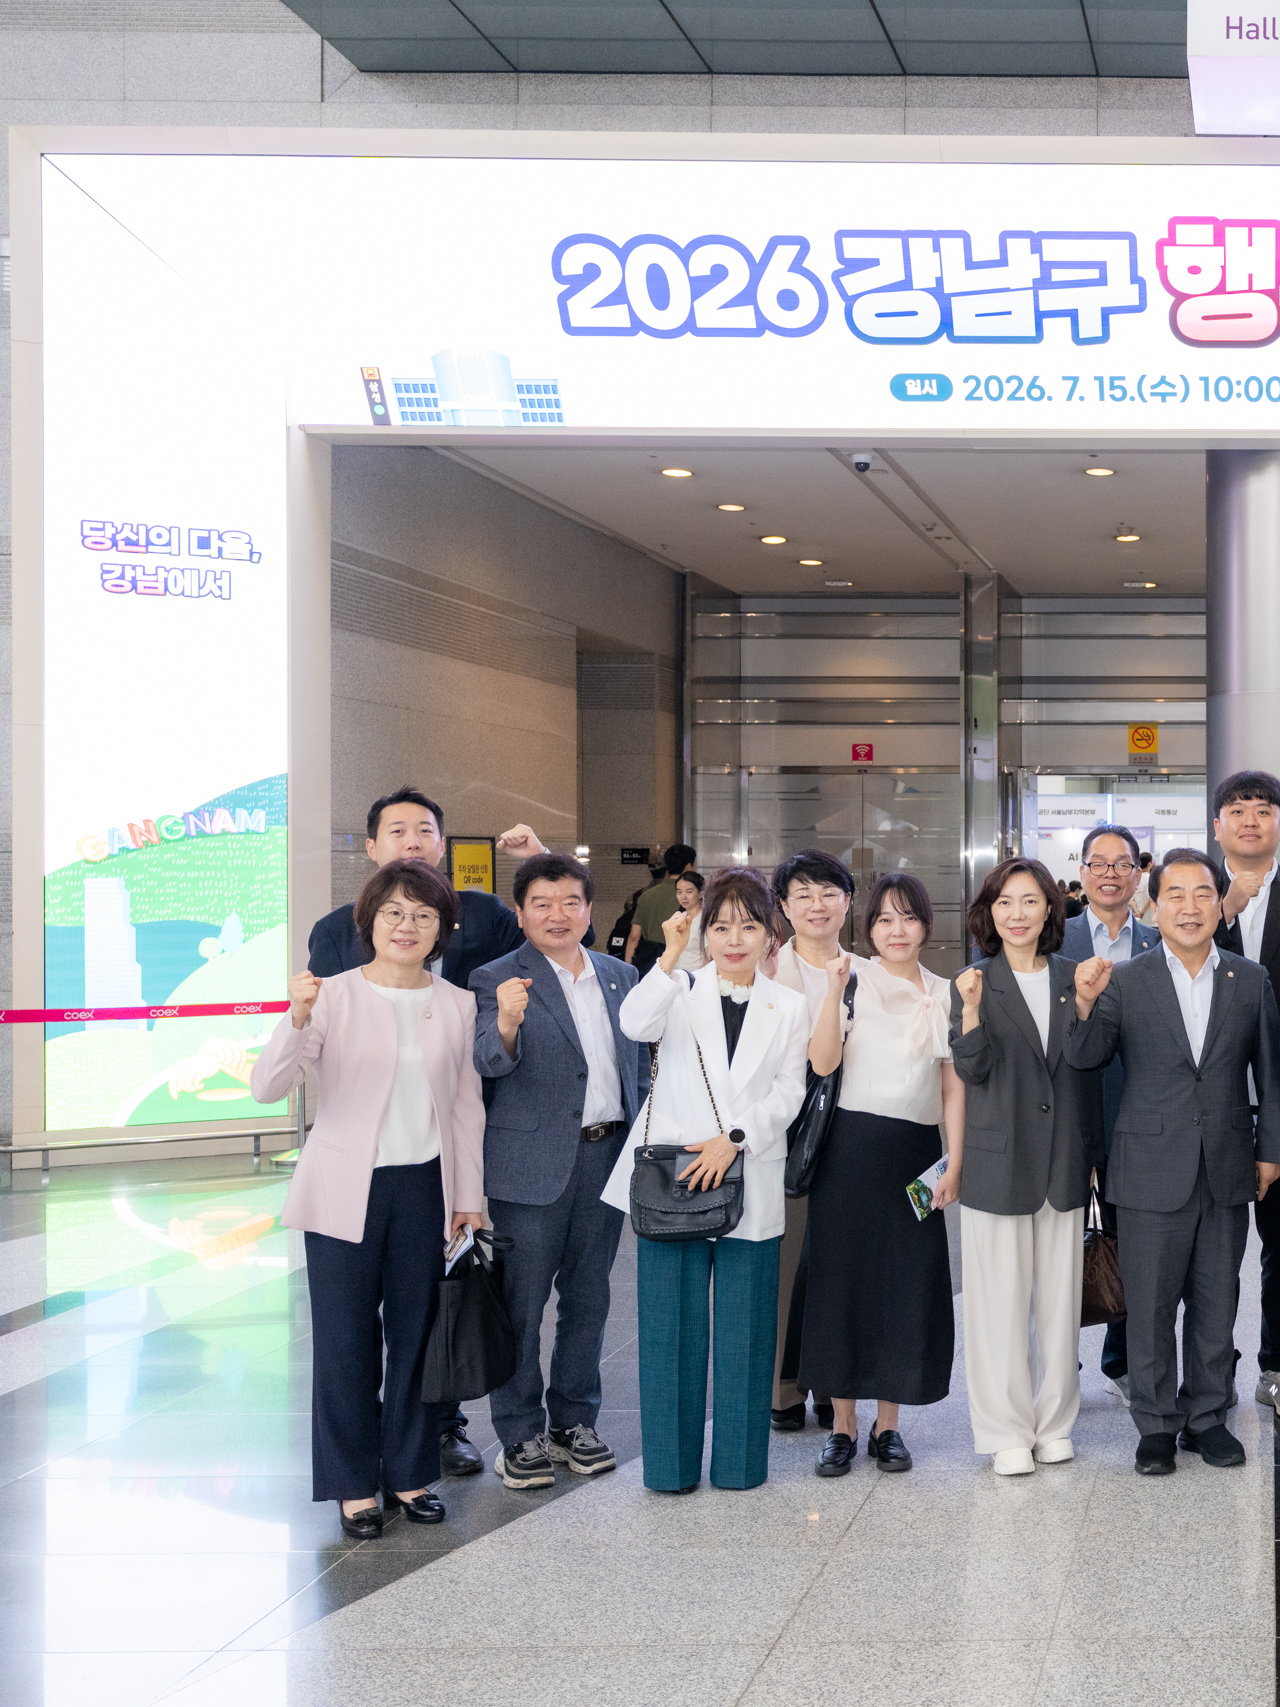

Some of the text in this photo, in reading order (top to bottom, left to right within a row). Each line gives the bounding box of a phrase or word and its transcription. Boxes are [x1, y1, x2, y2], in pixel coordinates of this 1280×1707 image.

[1225, 16, 1279, 41] Hall
[551, 233, 829, 339] 2026
[831, 229, 1147, 345] 강남구
[905, 378, 938, 396] 일시
[962, 374, 1053, 402] 2026.
[1061, 375, 1086, 402] 7.
[1093, 374, 1190, 403] 15.(수)
[80, 519, 262, 563] 당신의 다음,
[100, 562, 231, 600] 강남에서
[76, 807, 267, 862] GANGNAM
[1068, 852, 1079, 861] AI
[463, 875, 484, 884] QR code
[64, 1003, 263, 1020] coex coex coex
[1269, 1383, 1279, 1397] N
